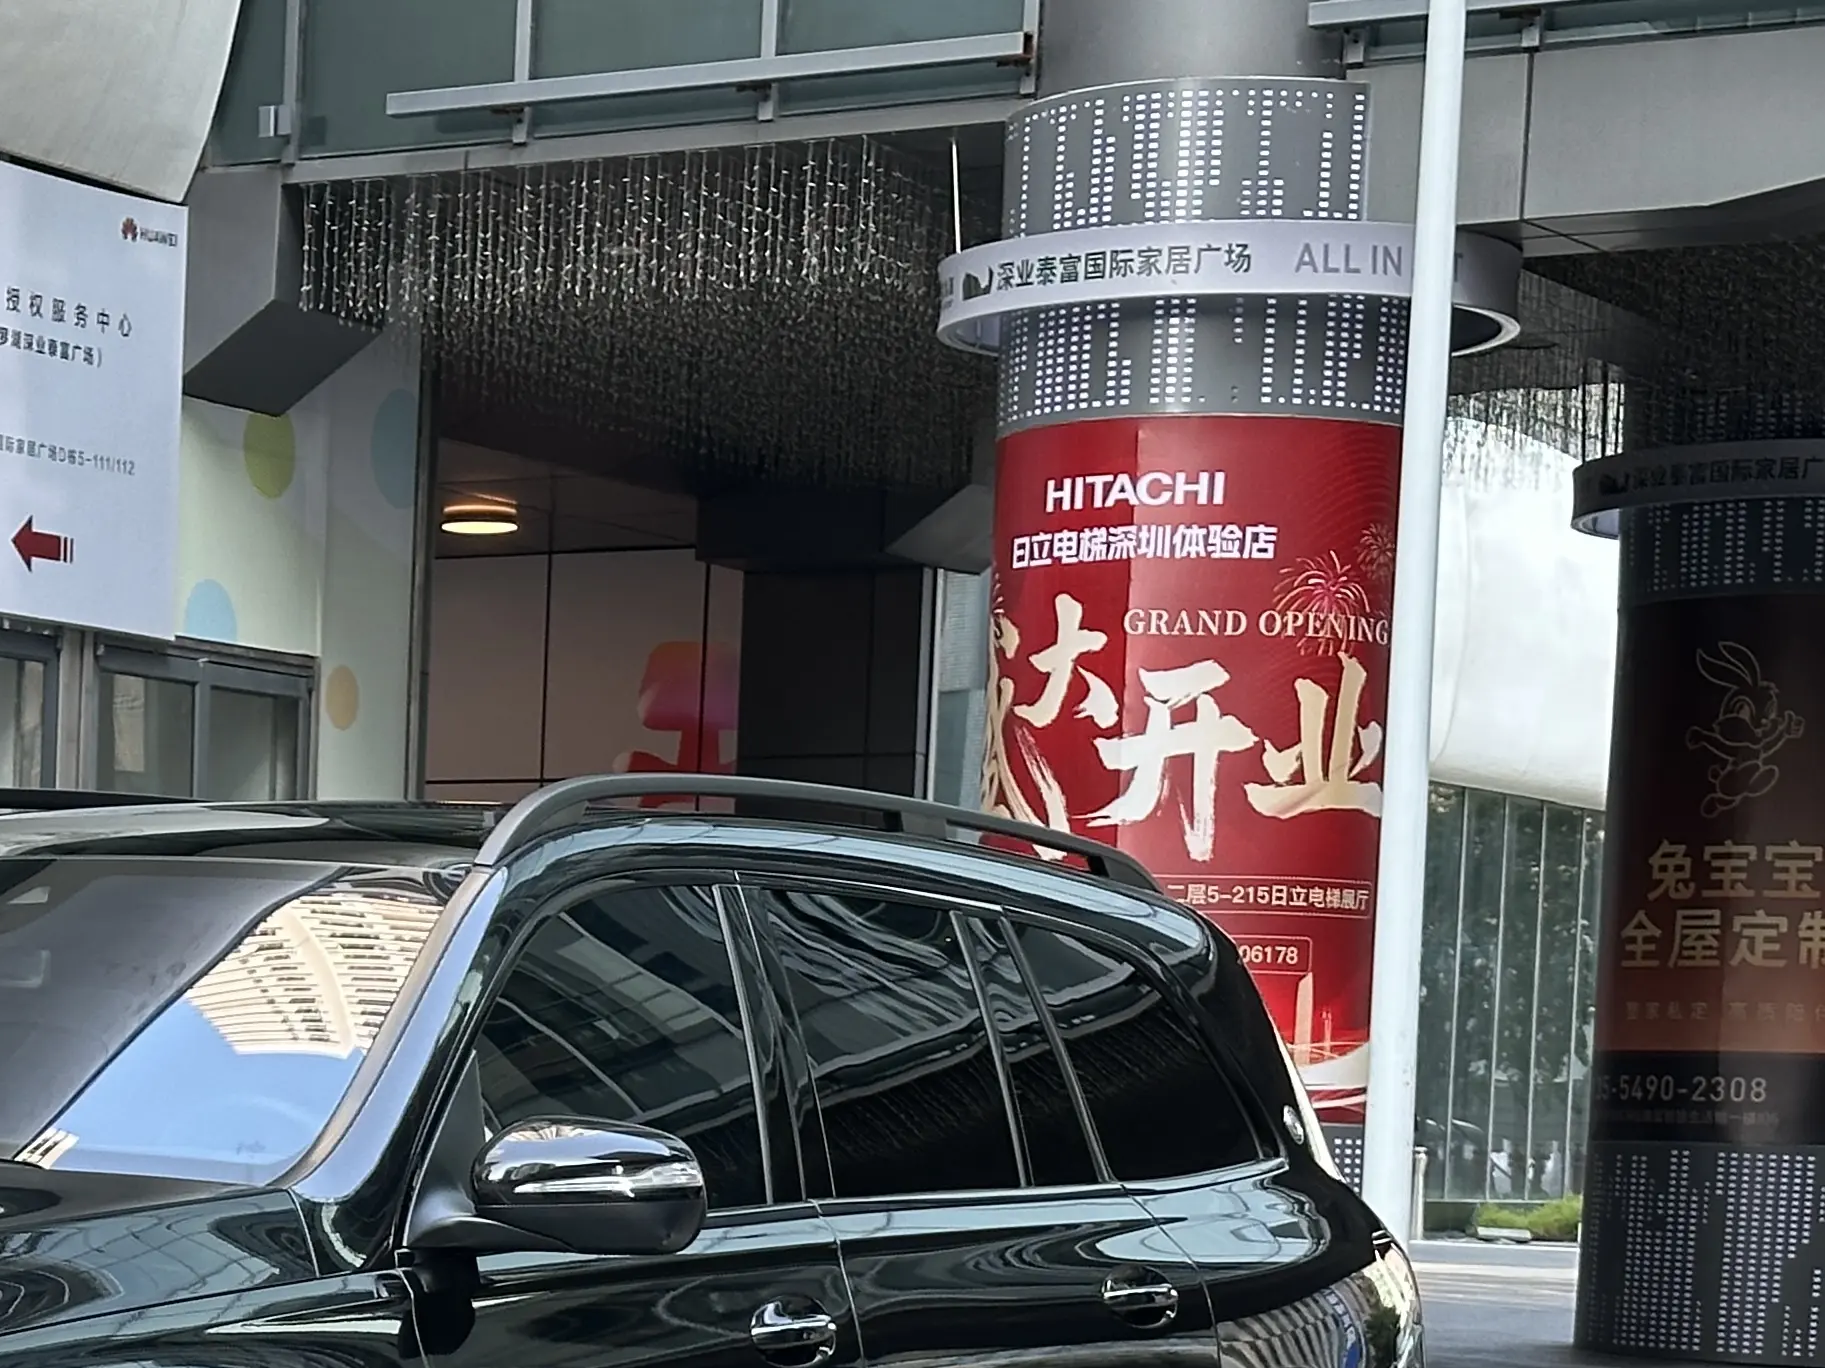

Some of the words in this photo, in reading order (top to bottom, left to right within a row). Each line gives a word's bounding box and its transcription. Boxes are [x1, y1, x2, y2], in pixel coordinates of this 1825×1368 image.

[995, 242, 1252, 291] 深业泰富国际家居广场
[1295, 243, 1361, 275] ALL
[1371, 243, 1403, 276] IN
[1045, 471, 1226, 513] HITACHI
[1012, 524, 1278, 569] 日立电梯深圳体验店
[1123, 608, 1248, 637] GRAND
[1258, 609, 1389, 646] OPENING
[1646, 838, 1824, 901] 兔宝宝
